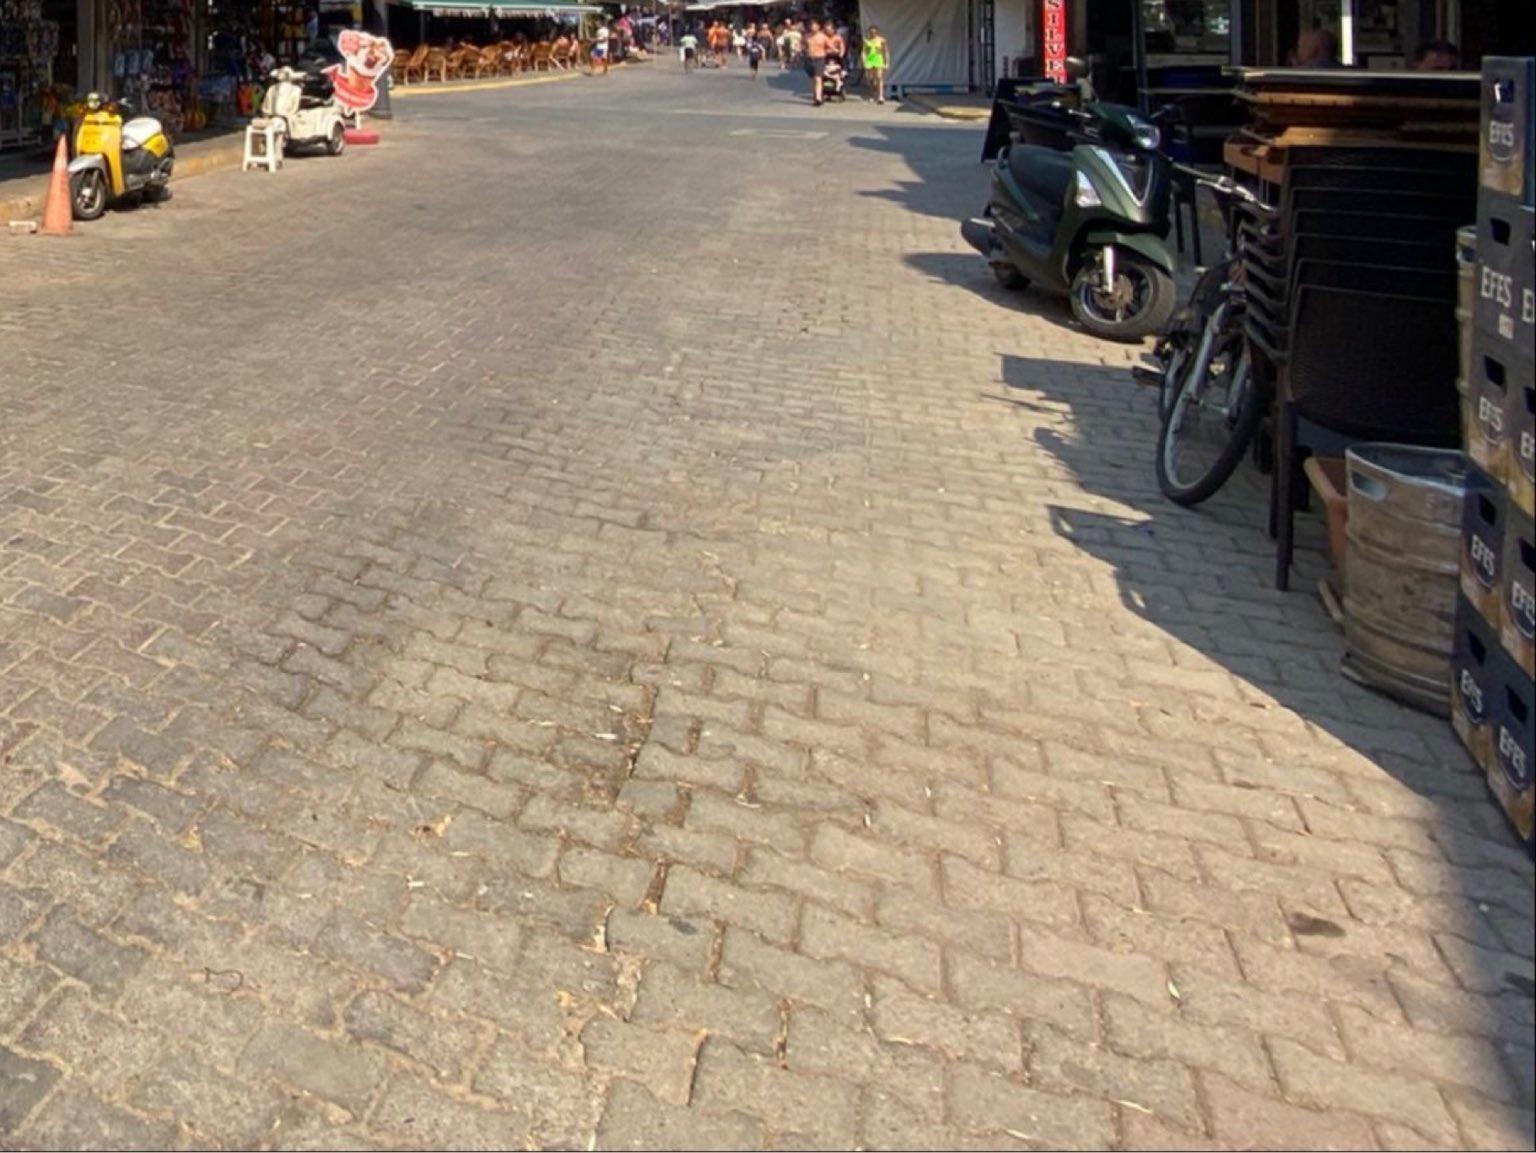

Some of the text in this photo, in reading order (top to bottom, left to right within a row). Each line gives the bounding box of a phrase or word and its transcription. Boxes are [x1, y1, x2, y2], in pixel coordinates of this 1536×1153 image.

[1489, 120, 1515, 147] EFES
[1481, 266, 1513, 308] EFES
[1470, 534, 1495, 577] EFES
[1498, 724, 1527, 779] EFES
